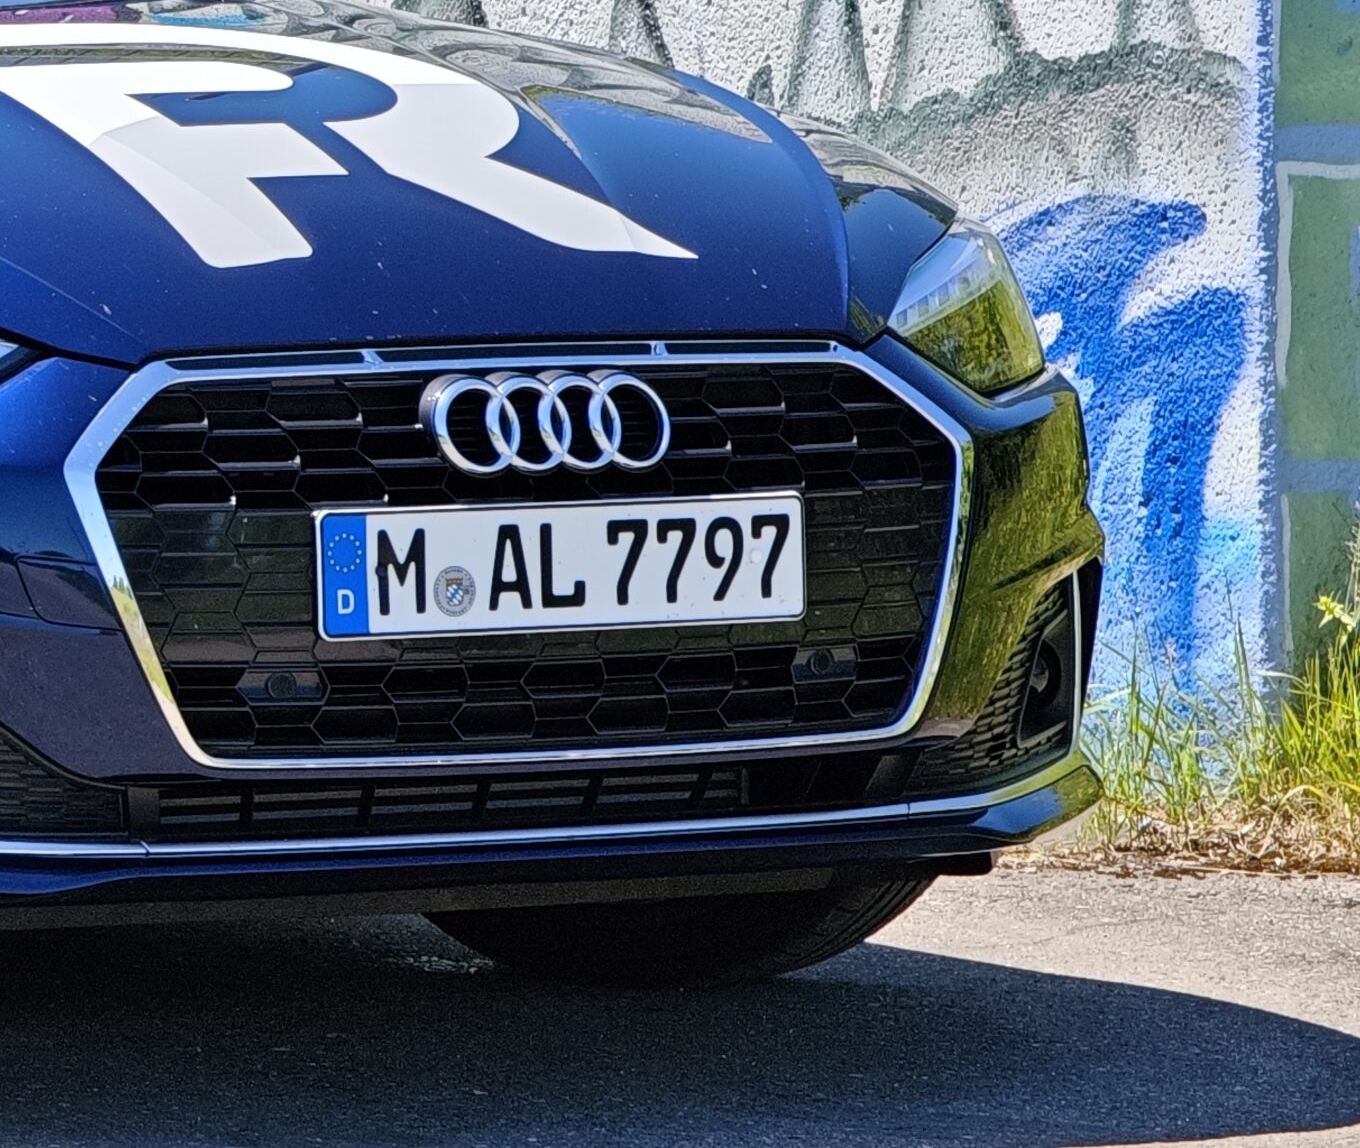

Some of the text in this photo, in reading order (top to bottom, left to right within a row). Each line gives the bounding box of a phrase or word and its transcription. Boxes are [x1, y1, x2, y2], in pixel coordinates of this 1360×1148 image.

[337, 589, 355, 615] D
[376, 528, 426, 616] M
[489, 523, 586, 611] AL
[607, 514, 790, 606] 7797
